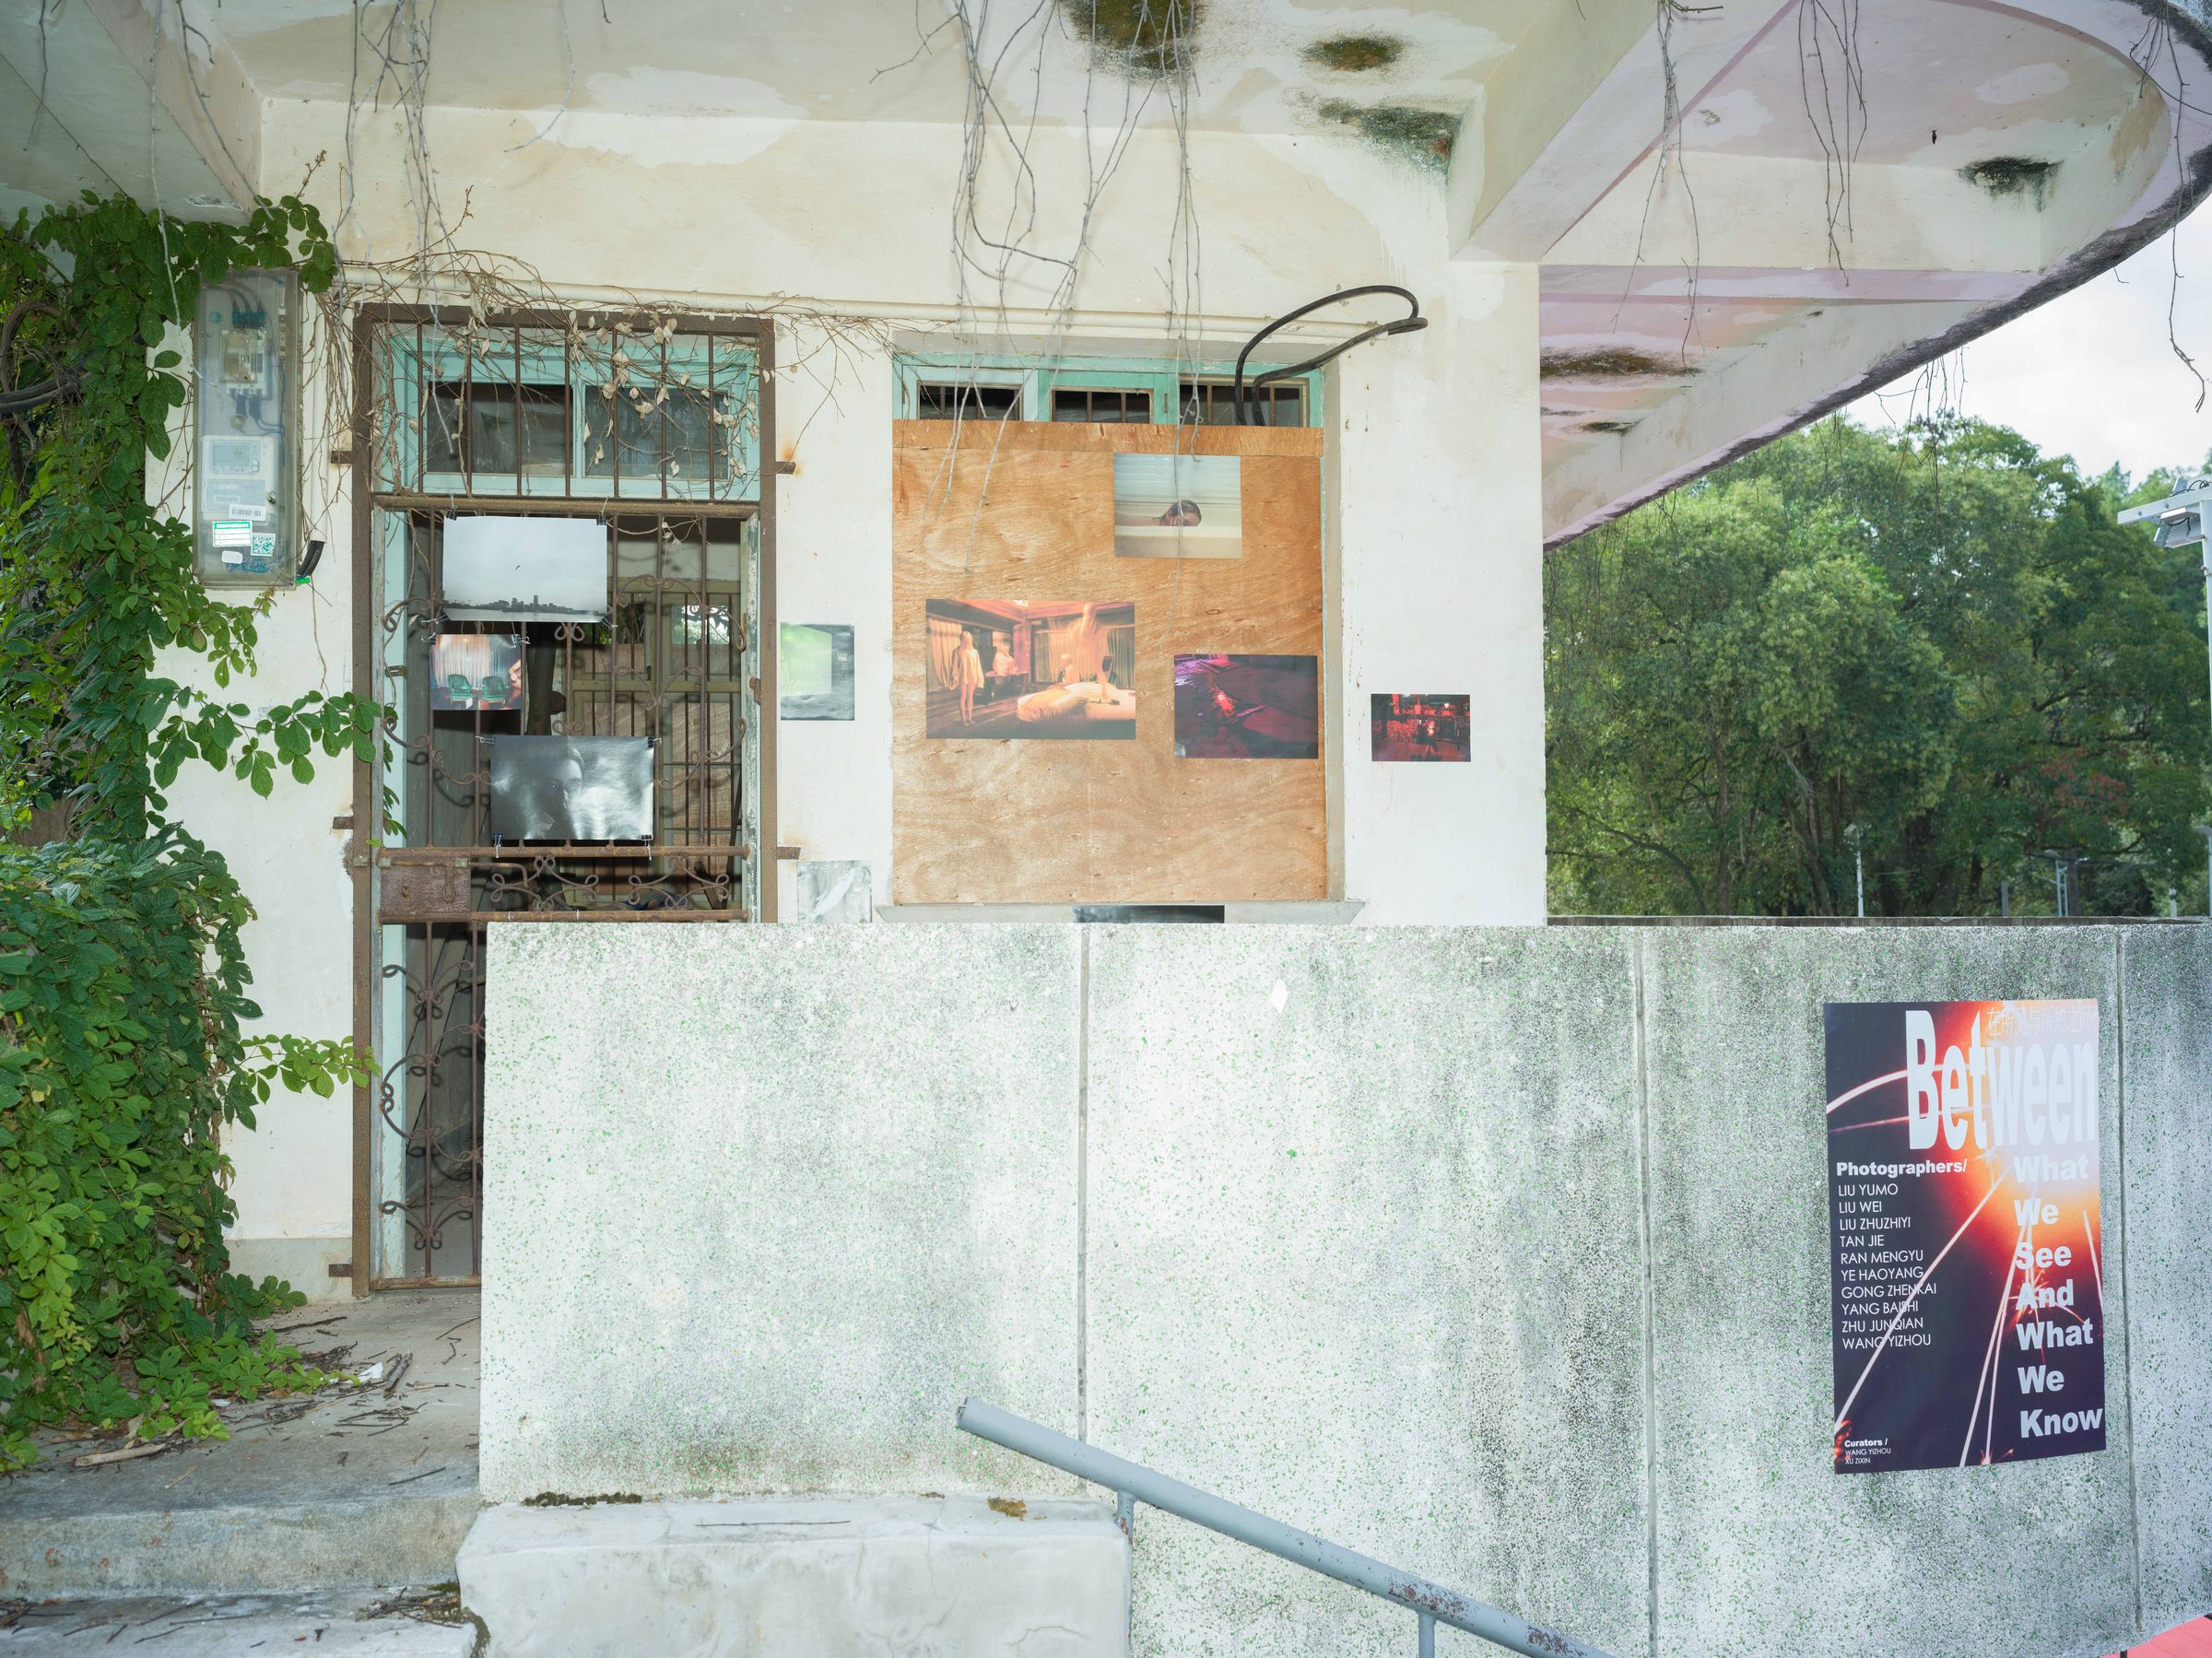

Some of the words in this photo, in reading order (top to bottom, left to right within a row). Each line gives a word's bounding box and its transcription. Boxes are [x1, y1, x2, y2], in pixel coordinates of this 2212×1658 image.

[1905, 1010, 2096, 1150] Between
[1836, 1158, 1968, 1178] Photographers/
[2013, 1154, 2089, 1183] What
[1838, 1184, 1855, 1197] LIU
[1858, 1183, 1899, 1196] YUMO
[1839, 1201, 1856, 1214] LIU
[1859, 1201, 1883, 1213] WEI
[2013, 1198, 2060, 1227] We
[1839, 1218, 1857, 1230] LIU
[1859, 1217, 1912, 1230] ZHUZHIYI
[1839, 1235, 1865, 1248] TAN
[1867, 1234, 1885, 1247] JIE
[1840, 1252, 1867, 1264] RAN
[1870, 1250, 1924, 1264] MENGYU
[2015, 1241, 2072, 1270] See
[1841, 1270, 1856, 1282] YE
[1859, 1266, 1924, 1281] HAOYANG
[1841, 1286, 1885, 1299] GONG
[1887, 1282, 1936, 1297] ZHENKAI
[2015, 1279, 2075, 1311] And
[1841, 1302, 1880, 1315] YANG
[1883, 1300, 1919, 1314] BAISHI
[1841, 1320, 1865, 1333] ZHU
[1868, 1317, 1924, 1332] JUNQIAN
[1887, 1334, 1932, 1347] YIZHOU
[2016, 1318, 2094, 1351] What
[2017, 1364, 2065, 1394] We
[2019, 1407, 2104, 1439] Know
[1844, 1439, 1883, 1447] Curators
